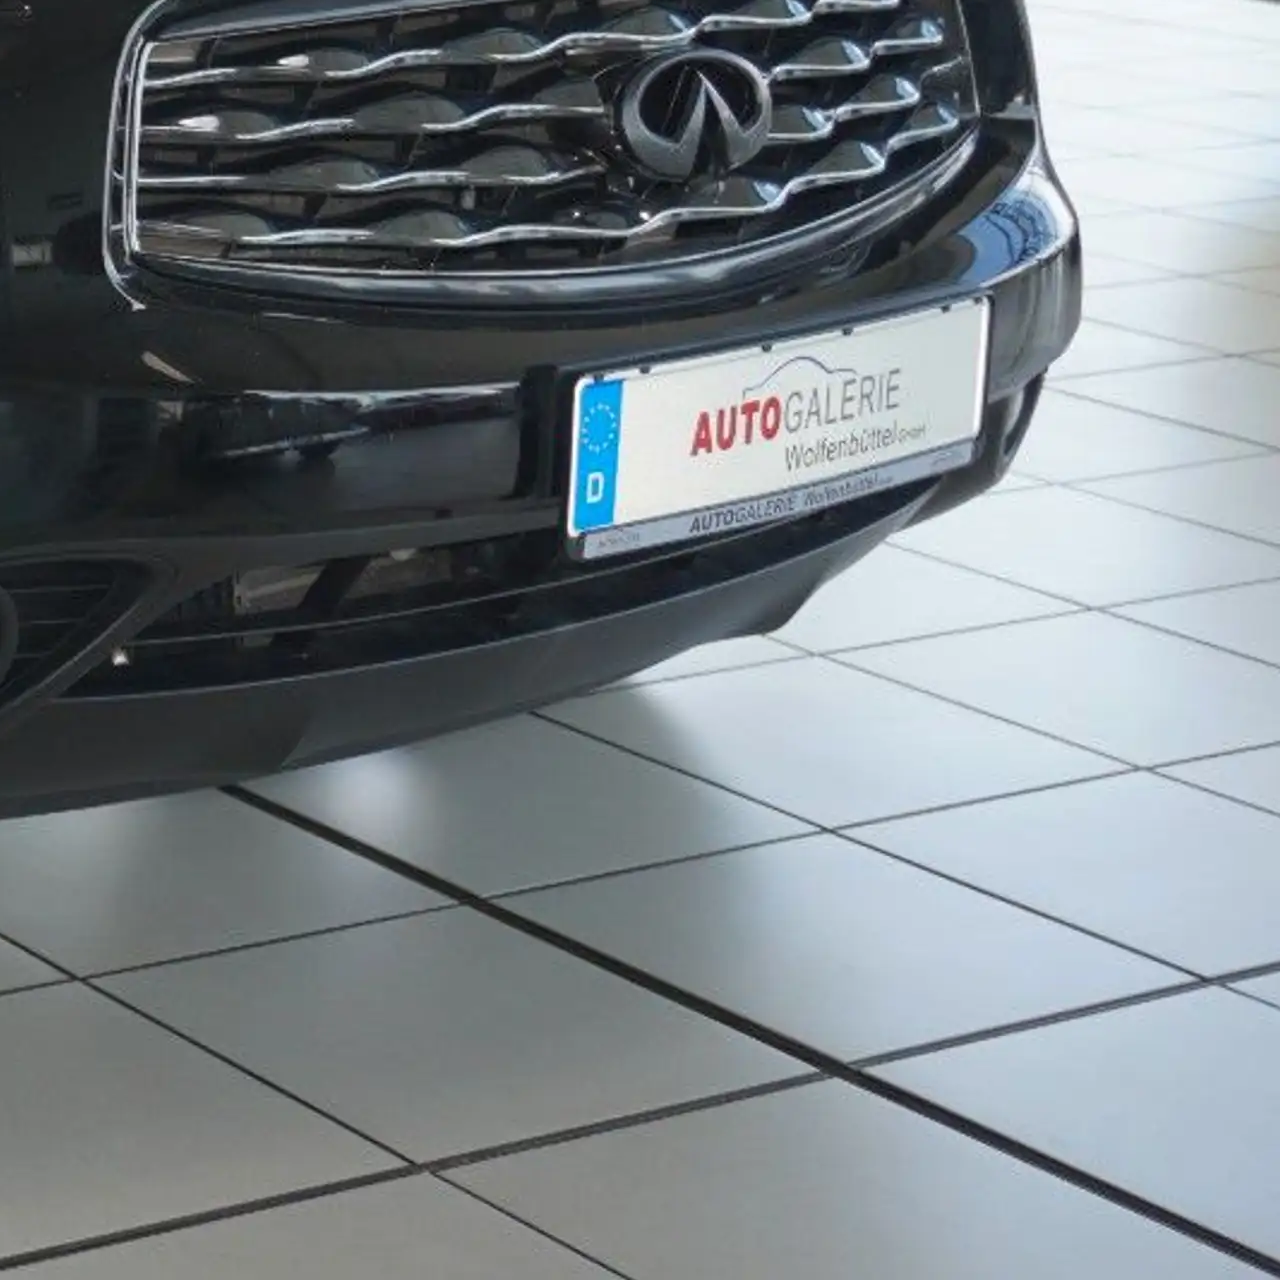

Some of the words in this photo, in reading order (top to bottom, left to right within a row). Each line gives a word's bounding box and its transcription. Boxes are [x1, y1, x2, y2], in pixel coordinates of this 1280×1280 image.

[690, 368, 901, 457] AUTOGALERIE
[586, 471, 605, 504] D
[689, 494, 797, 534] AUTOGALERIE
